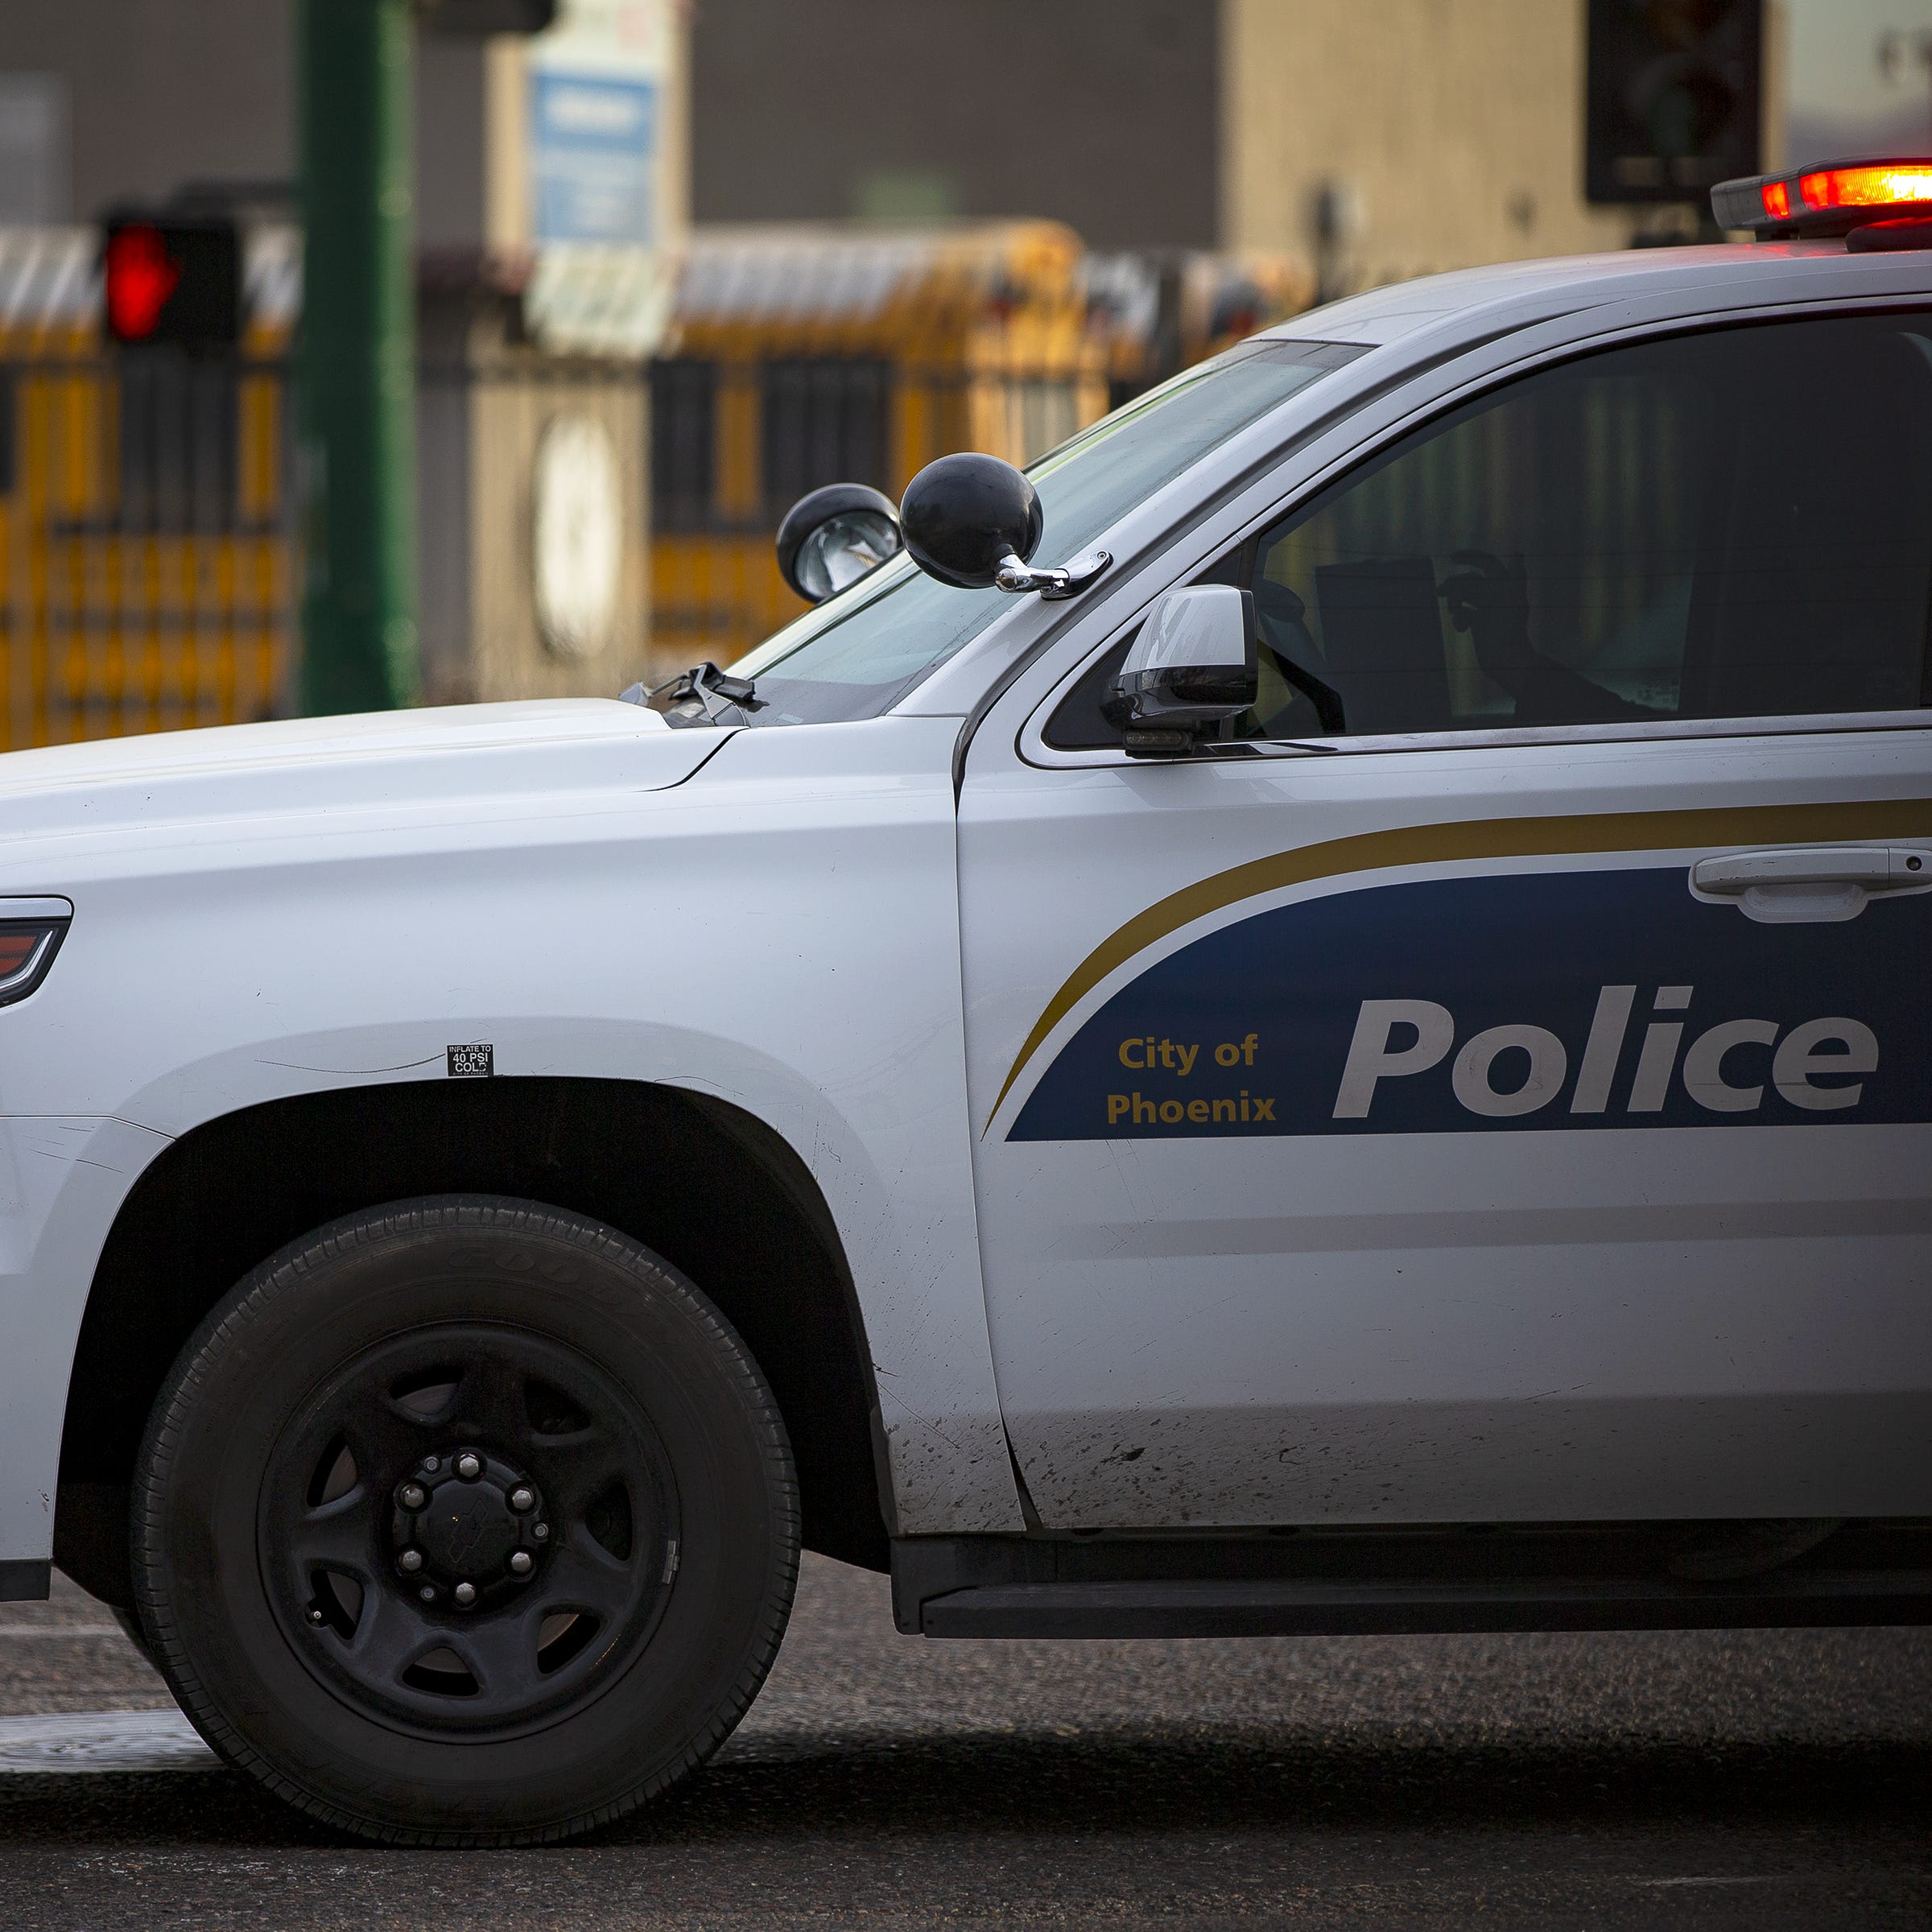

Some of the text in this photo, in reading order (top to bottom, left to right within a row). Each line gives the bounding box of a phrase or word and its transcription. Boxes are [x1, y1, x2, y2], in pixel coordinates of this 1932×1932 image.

[452, 1052, 489, 1063] 40 PSI
[1118, 1033, 1258, 1076] City of
[1332, 985, 1880, 1117] Police
[1107, 1090, 1278, 1125] Phoenix
